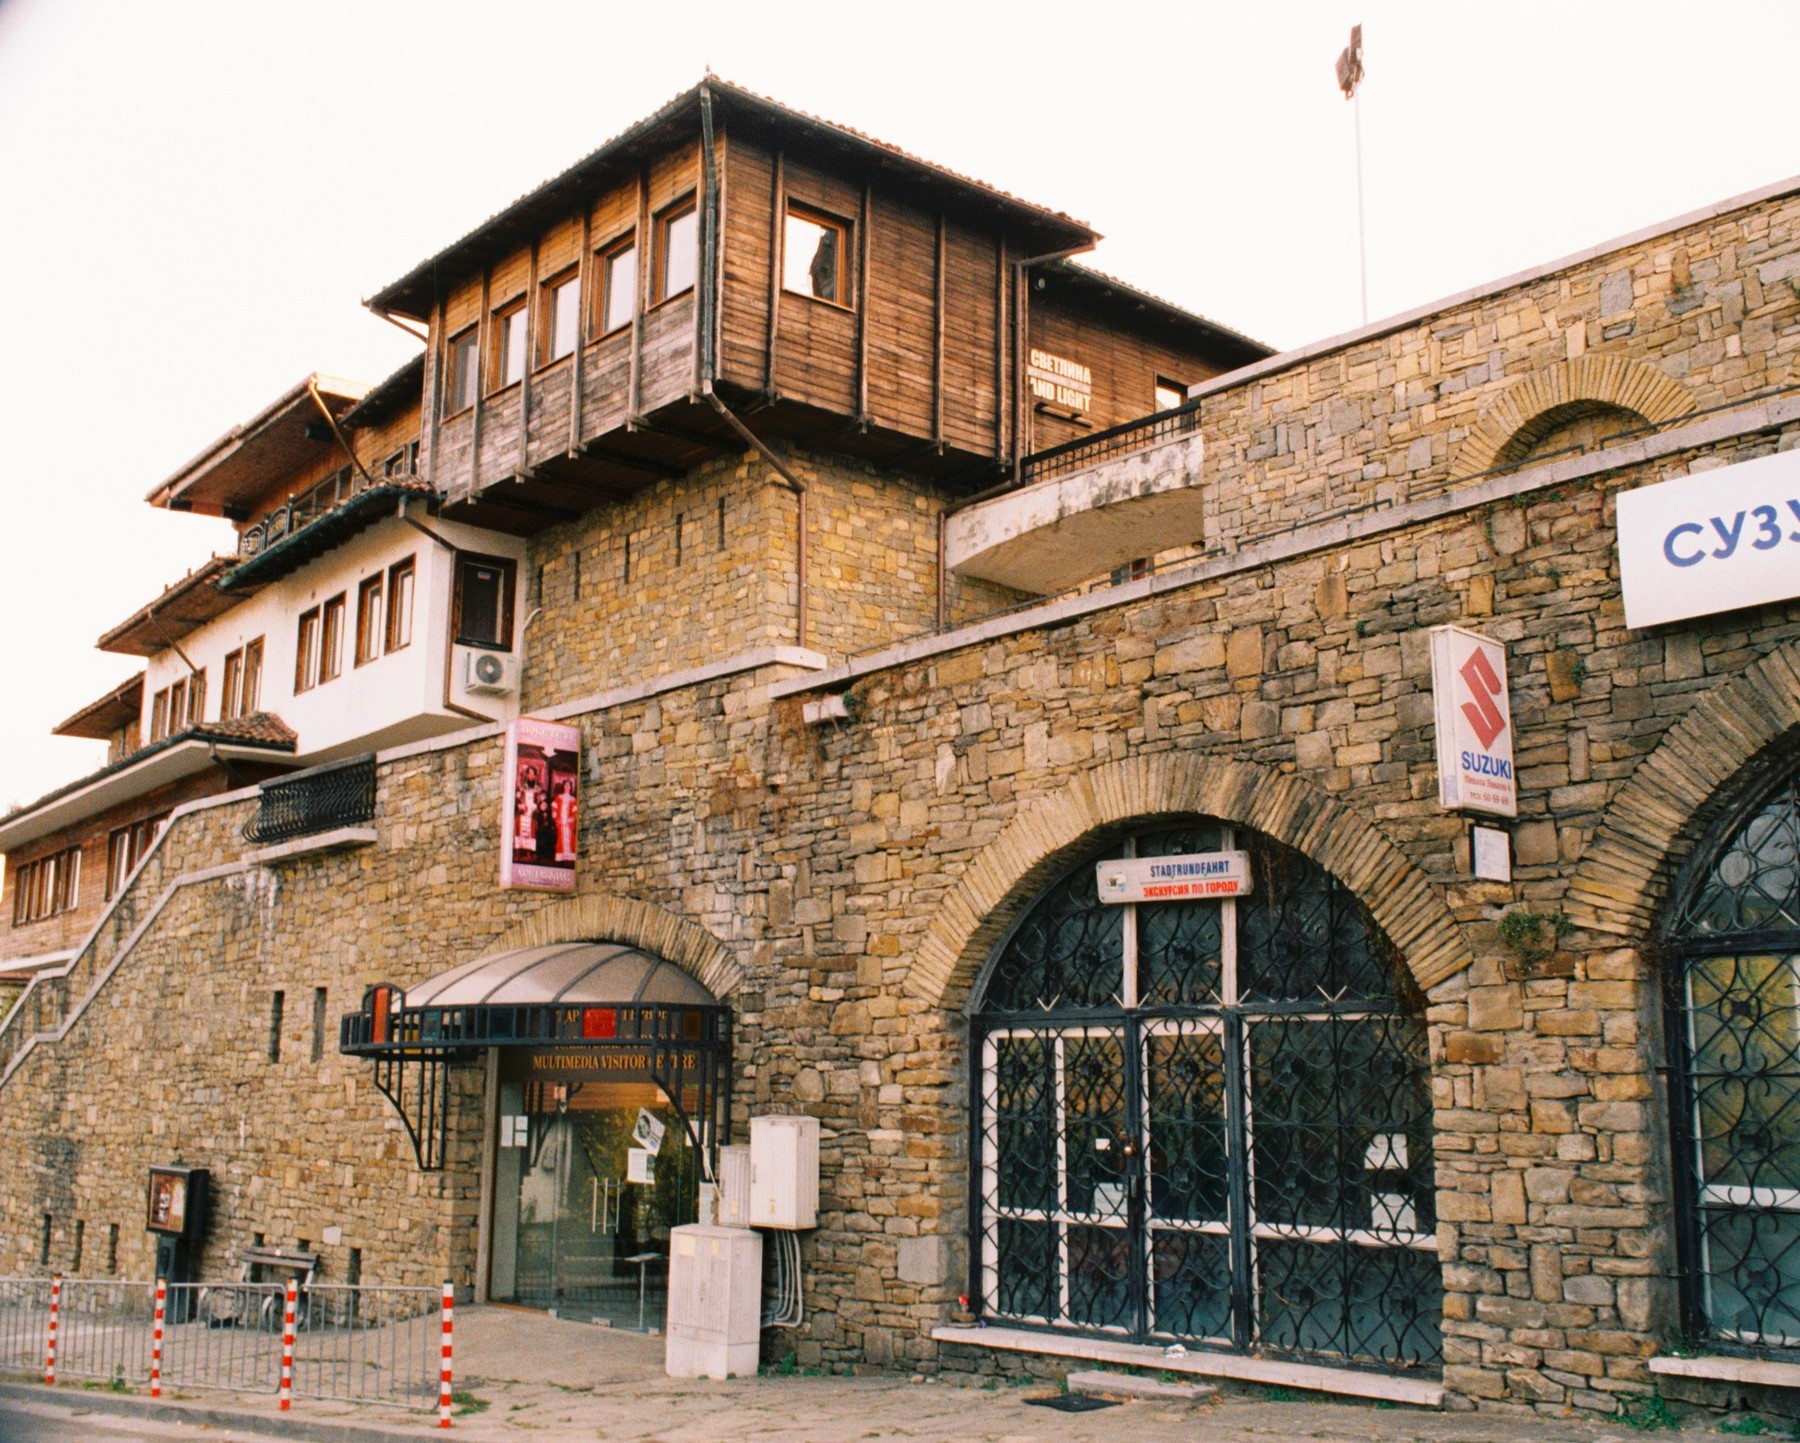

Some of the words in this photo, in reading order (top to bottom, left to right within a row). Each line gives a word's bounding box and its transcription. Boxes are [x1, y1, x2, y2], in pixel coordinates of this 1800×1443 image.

[1030, 349, 1092, 385] СВЕТЛИНА
[1056, 385, 1091, 412] LIGHT
[1461, 751, 1512, 780] SUZUKI
[1150, 860, 1230, 878] STADTRUNDFAHRT
[1143, 884, 1189, 898] ЭКСКУРСИЯ
[1192, 883, 1204, 894] ПО
[1206, 880, 1239, 894] ГОРОДУ
[533, 1055, 599, 1070] MULTIMEDIA
[601, 1055, 645, 1069] VISITOR
